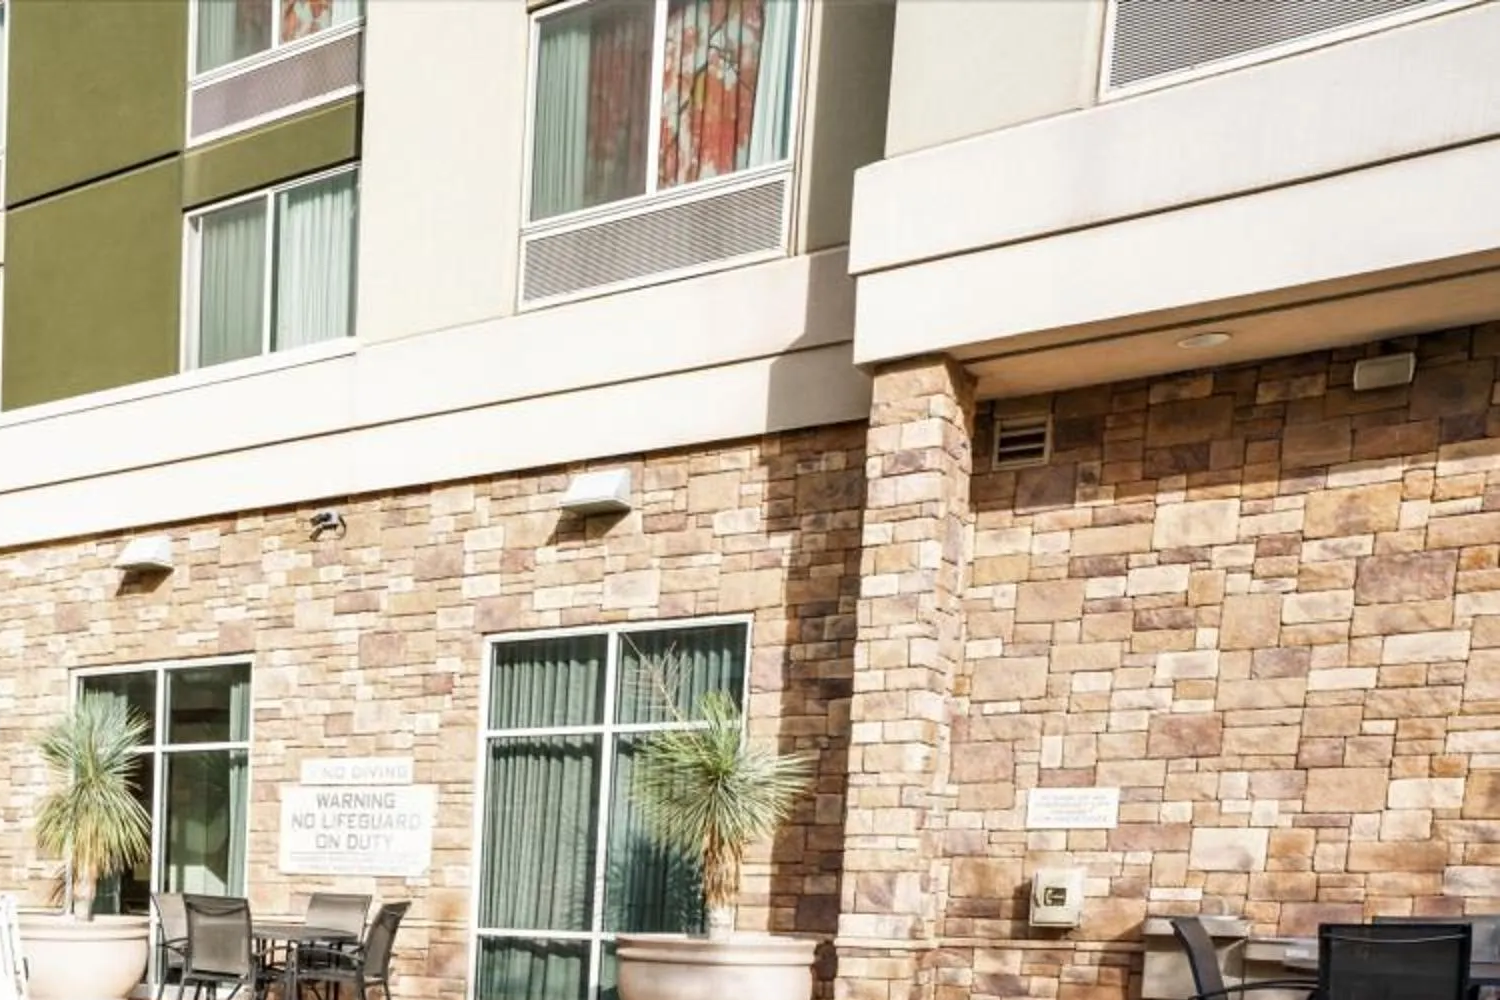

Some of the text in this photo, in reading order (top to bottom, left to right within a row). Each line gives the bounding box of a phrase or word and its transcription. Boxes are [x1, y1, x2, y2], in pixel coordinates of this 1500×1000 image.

[321, 765, 408, 779] NO DIVING
[316, 792, 397, 809] WARNING
[291, 813, 422, 831] NO LIFEGUARD
[315, 834, 395, 850] ON DUTY
